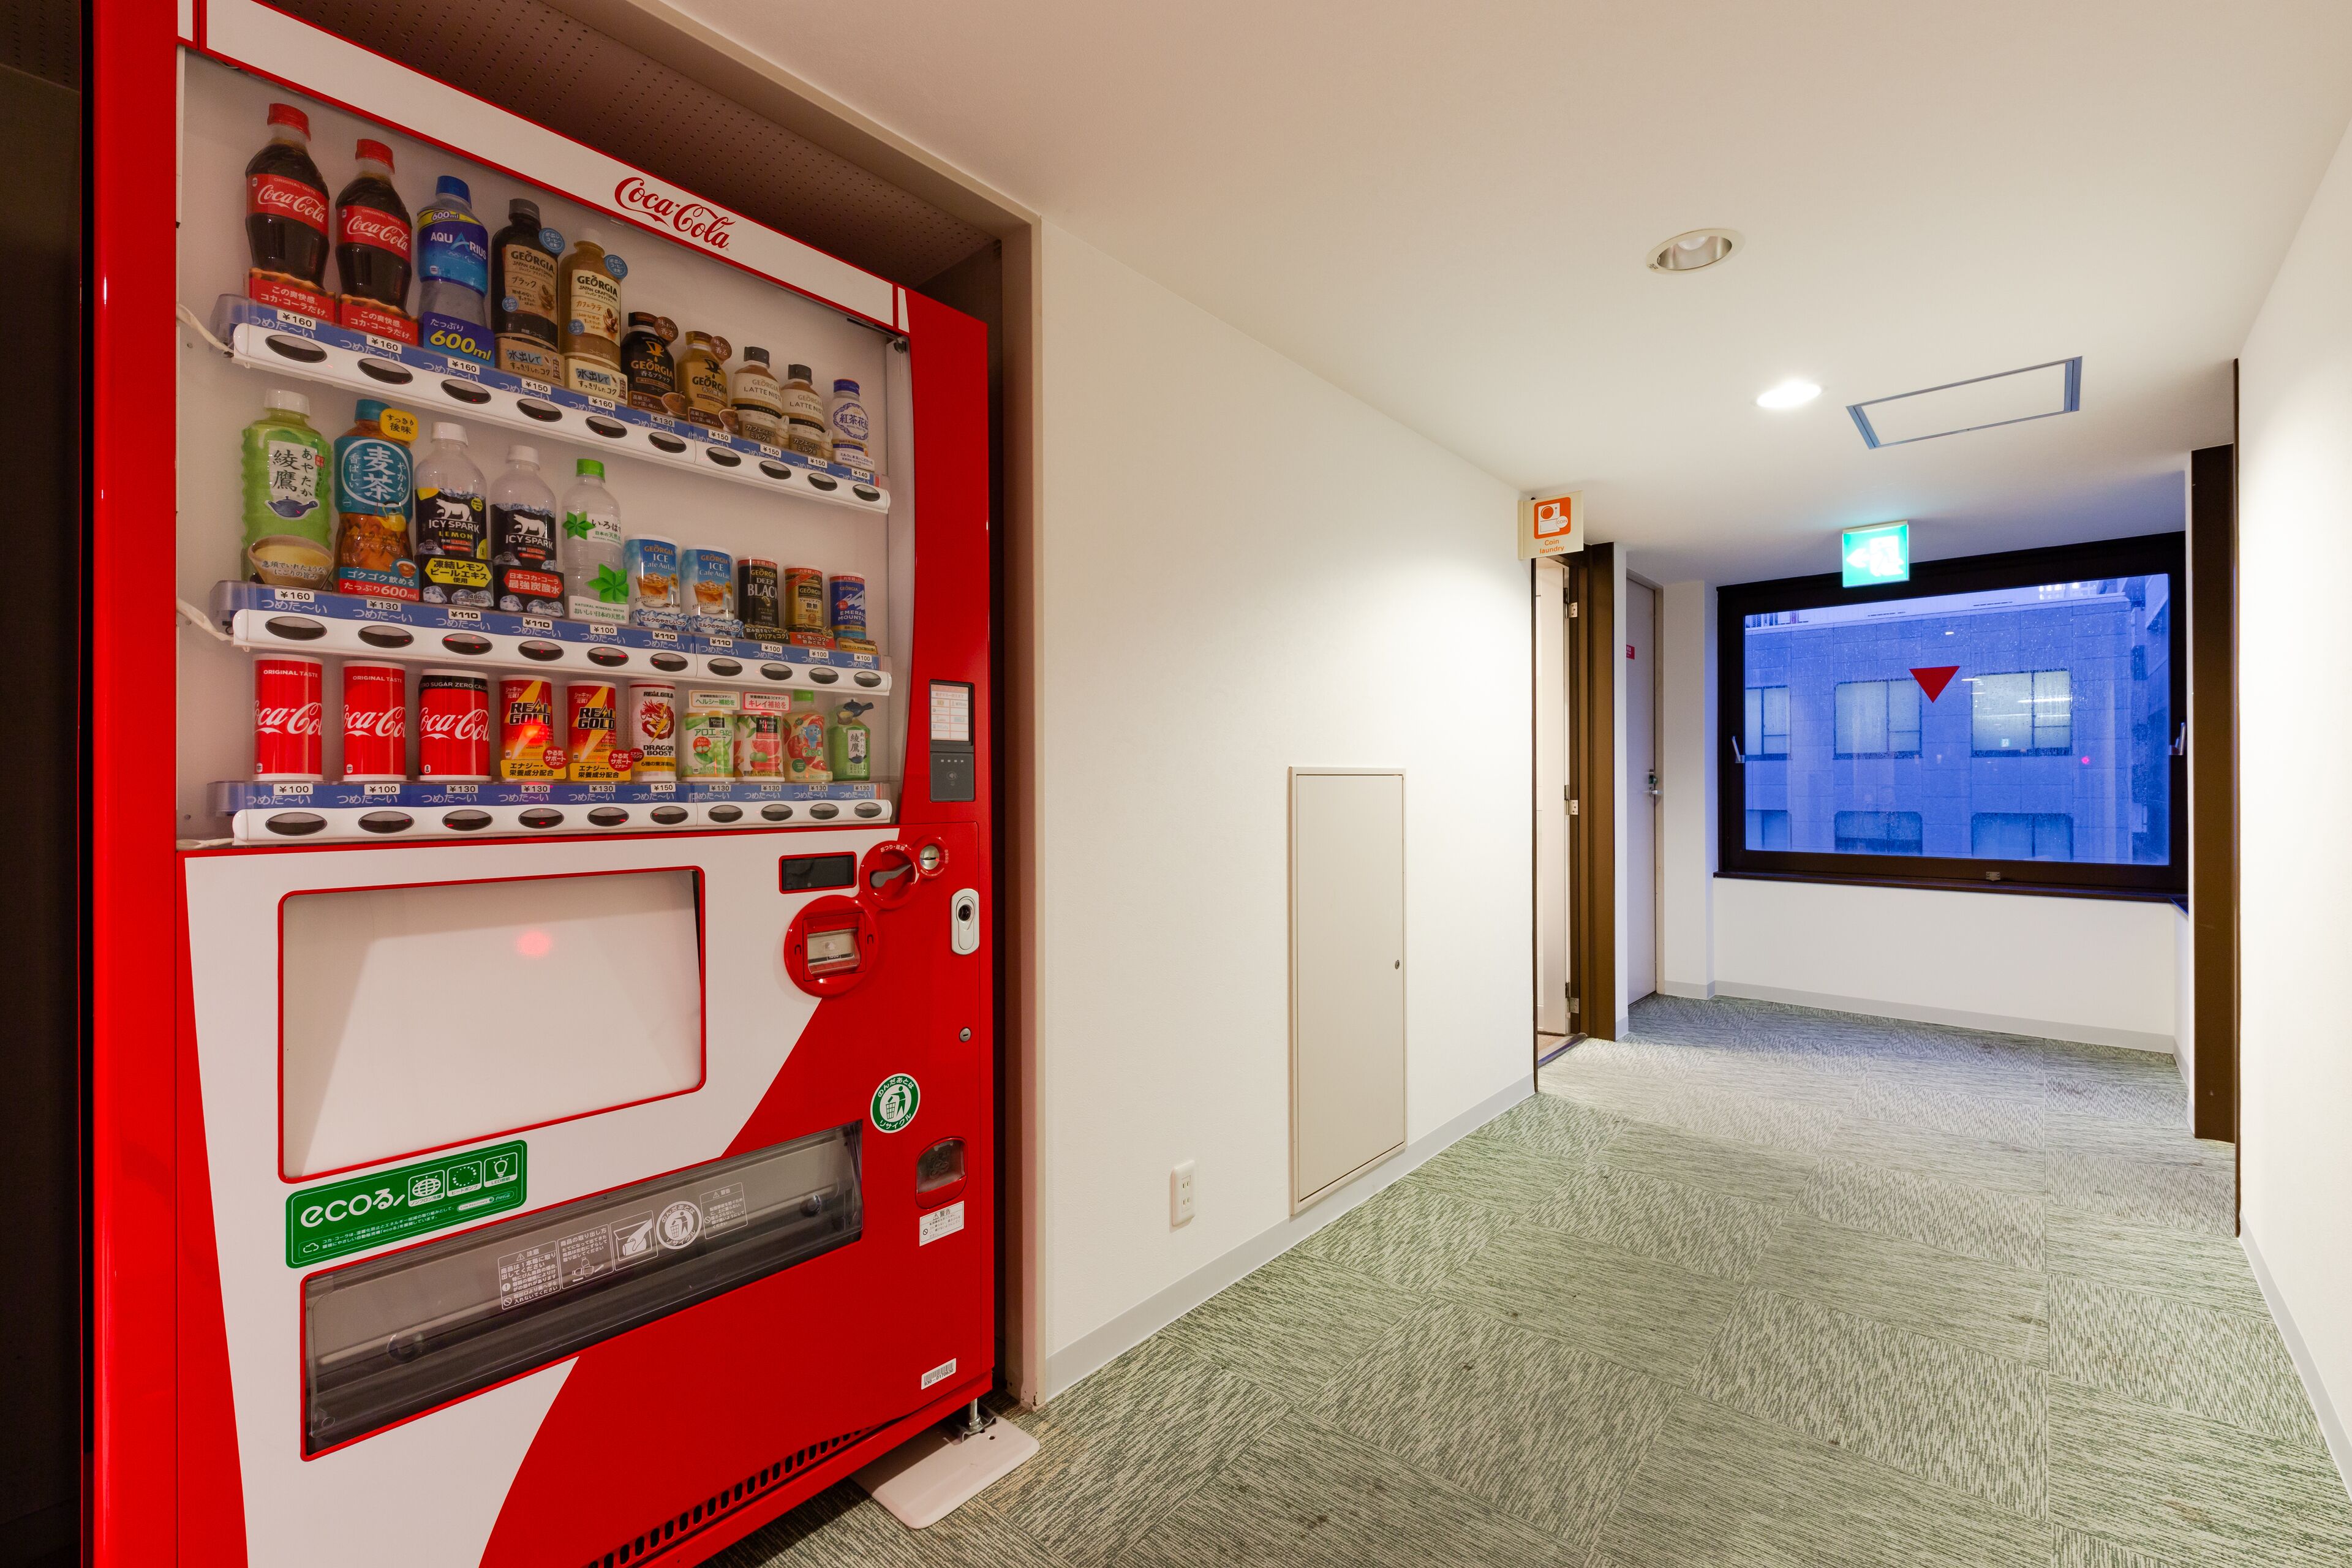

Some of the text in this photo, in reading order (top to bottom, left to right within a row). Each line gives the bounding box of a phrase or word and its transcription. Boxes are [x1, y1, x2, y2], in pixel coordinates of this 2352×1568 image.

[274, 178, 300, 188] ORIGINAL
[258, 185, 326, 223] Coca-Cola
[362, 209, 386, 219] ORIGINAL
[432, 211, 459, 220] 600ml
[614, 177, 736, 249] Coca-Cola
[347, 216, 409, 251] Coca-Cola
[431, 230, 486, 259] AQUARIUS
[511, 251, 554, 274] GEORGIA
[512, 276, 536, 288] ブラック
[577, 275, 617, 297] GEORGIA
[272, 286, 318, 305] この爽快感。
[261, 293, 328, 317] コカ・コーラだけ。
[576, 301, 603, 311] カフェラテ
[361, 311, 403, 328] この爽快感。
[430, 319, 464, 331] たっぷり
[350, 318, 412, 340] コカ・コーラだけ。
[661, 328, 674, 337] 香る
[430, 330, 492, 360] 600ml
[715, 347, 727, 356] 香る
[508, 349, 540, 363] 水出しで
[577, 368, 609, 383] 水出しで
[631, 359, 674, 377] GEORGIA
[692, 375, 726, 394] GEORGIA
[752, 379, 778, 390] GEORGIA
[387, 414, 414, 426] すっきり
[390, 423, 412, 435] 後味
[272, 450, 300, 492] 綾鷹
[301, 448, 314, 497] あやたか
[349, 453, 360, 488] 香ばしい
[363, 446, 396, 500] 麦茶
[397, 462, 407, 499] やかんの
[448, 521, 480, 533] SPARK
[506, 535, 553, 550] ICY SPARK
[1540, 545, 1564, 554] laundry
[644, 545, 674, 556] GEORGIA
[654, 554, 668, 562] ICE
[434, 560, 483, 571] 凍結レモン
[701, 554, 728, 564] GEORGIA
[709, 562, 723, 571] ICE
[347, 571, 415, 586] ゴクゴク飲める
[510, 573, 558, 584] 日本コカ・コーラ
[751, 569, 776, 578] GEORGIA
[509, 579, 559, 594] 最強炭酸水
[370, 601, 398, 610] ¥130
[574, 608, 625, 620] おいしい日本の天然水
[642, 616, 686, 626] ミルクのやさしいコク
[699, 622, 739, 631] ミルクのやさしいコク
[510, 699, 548, 714] REAL
[579, 704, 614, 718] REAL
[748, 700, 786, 709] キレイ補給を
[510, 713, 550, 725] GOLD
[578, 718, 615, 729] GOLD
[878, 1077, 914, 1097] のんだあとは
[880, 1112, 911, 1129] リサイクル
[491, 1177, 510, 1185] LED照明
[451, 1185, 478, 1195] ヒートポンプ
[662, 1205, 696, 1223] のんだあとは
[561, 1228, 606, 1246] 商品の取り出し方
[563, 1235, 606, 1252] たてになって出てきた
[666, 1230, 696, 1245] リサイクル
[564, 1246, 603, 1262] 取り出してください
[502, 1262, 545, 1280] 出してください
[514, 1286, 557, 1304] 入れないでください
